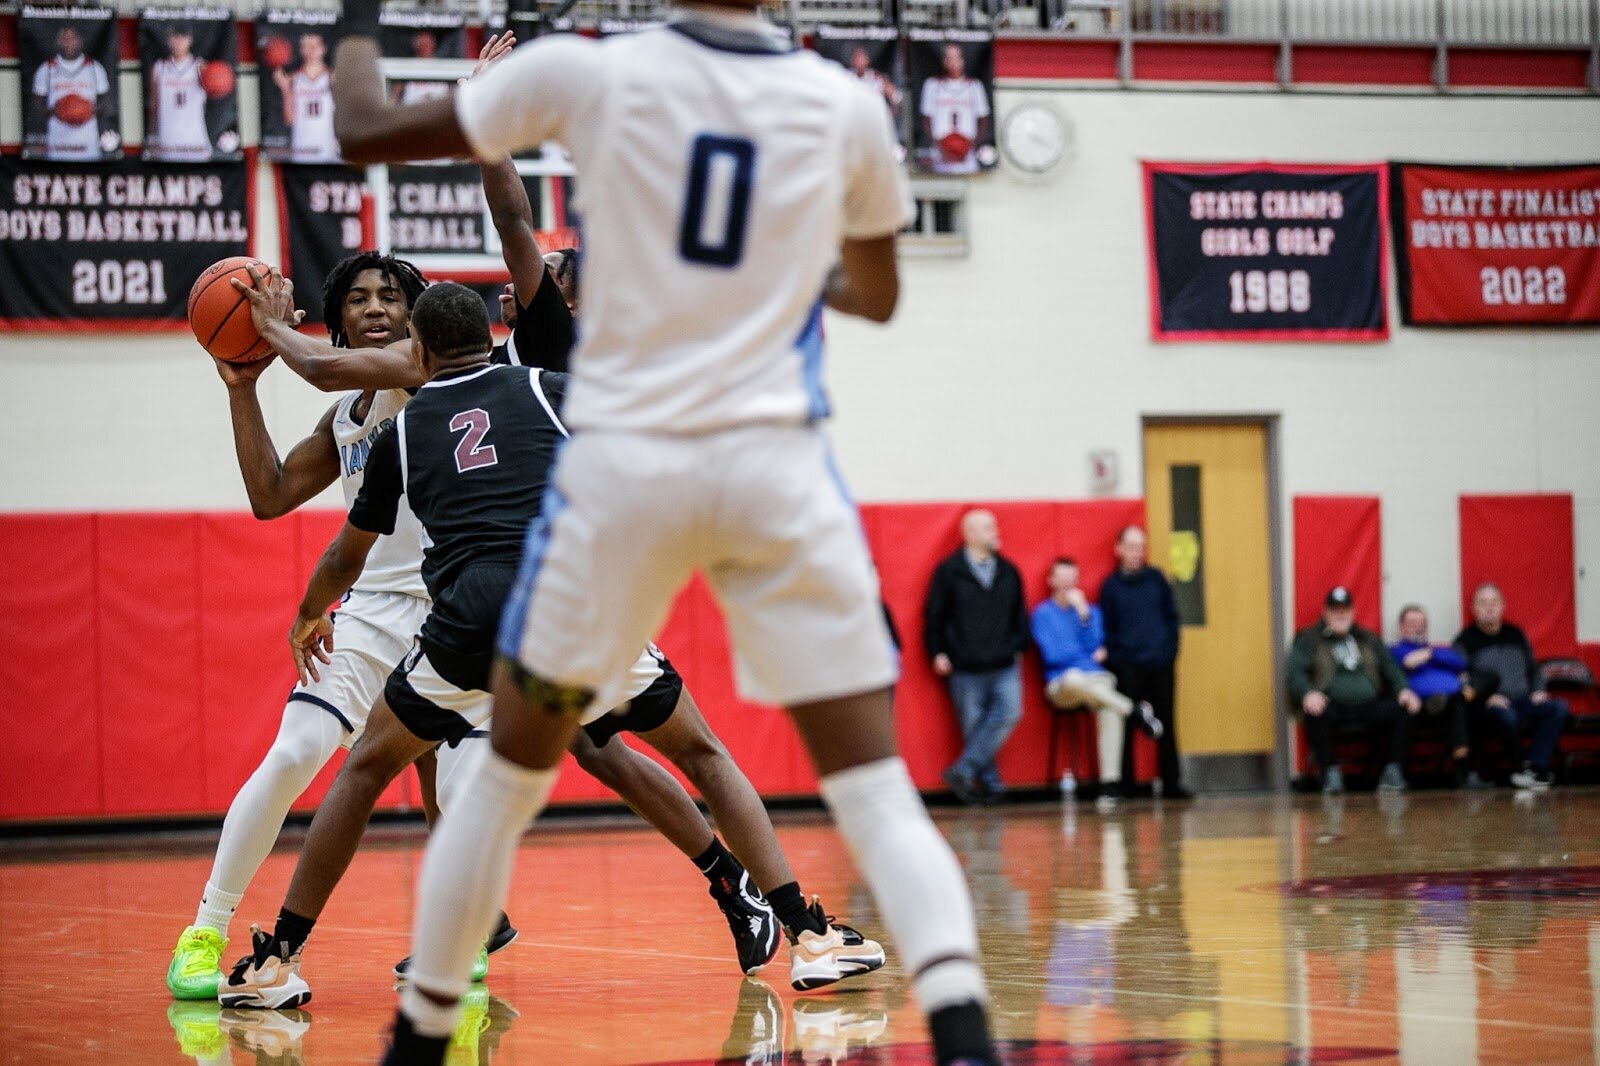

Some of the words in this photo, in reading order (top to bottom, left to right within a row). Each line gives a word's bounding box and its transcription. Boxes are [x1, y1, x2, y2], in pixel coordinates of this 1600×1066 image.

[13, 174, 102, 205] STATE
[106, 174, 223, 206] CHAMPS
[309, 180, 397, 213] STA
[678, 133, 756, 268] 0
[1190, 189, 1257, 220] STATE
[1261, 189, 1344, 219] CHAMPS
[1421, 187, 1496, 217] STATE
[66, 209, 248, 242] BASKETBALL
[341, 216, 482, 249] BEBALL
[1201, 227, 1270, 257] GIRLS
[1276, 227, 1335, 256] GOLF
[1411, 219, 1471, 249] BOYS
[1473, 220, 1600, 249] BASKETBA
[72, 259, 168, 304] 2021
[1229, 270, 1311, 313] 1988
[1480, 265, 1567, 305] 2022
[450, 407, 498, 474] 2
